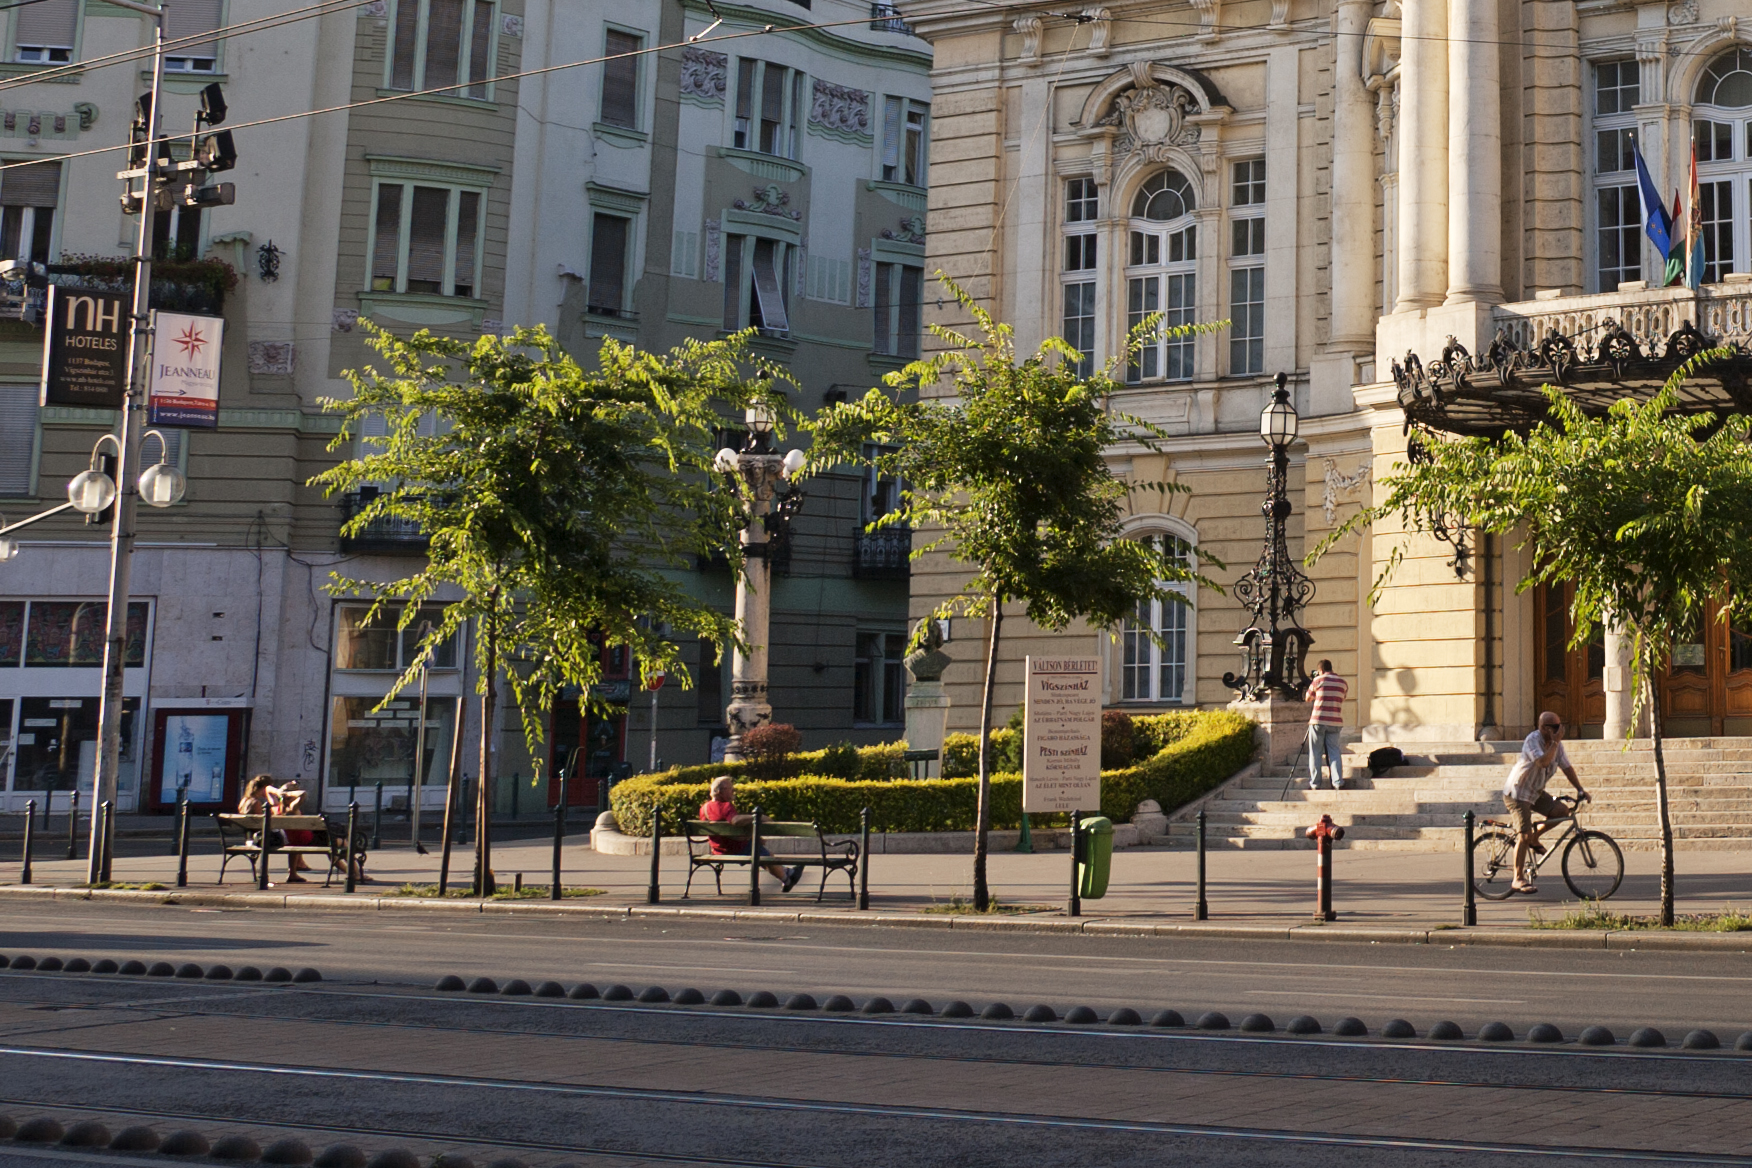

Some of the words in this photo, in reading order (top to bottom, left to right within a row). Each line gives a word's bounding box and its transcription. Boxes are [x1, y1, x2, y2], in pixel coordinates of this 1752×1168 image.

[65, 296, 120, 333] nH
[65, 335, 118, 350] HOTELES
[159, 364, 216, 380] JEANNEAU
[1033, 657, 1062, 671] VÁLTSON
[1040, 745, 1058, 757] PESTI
